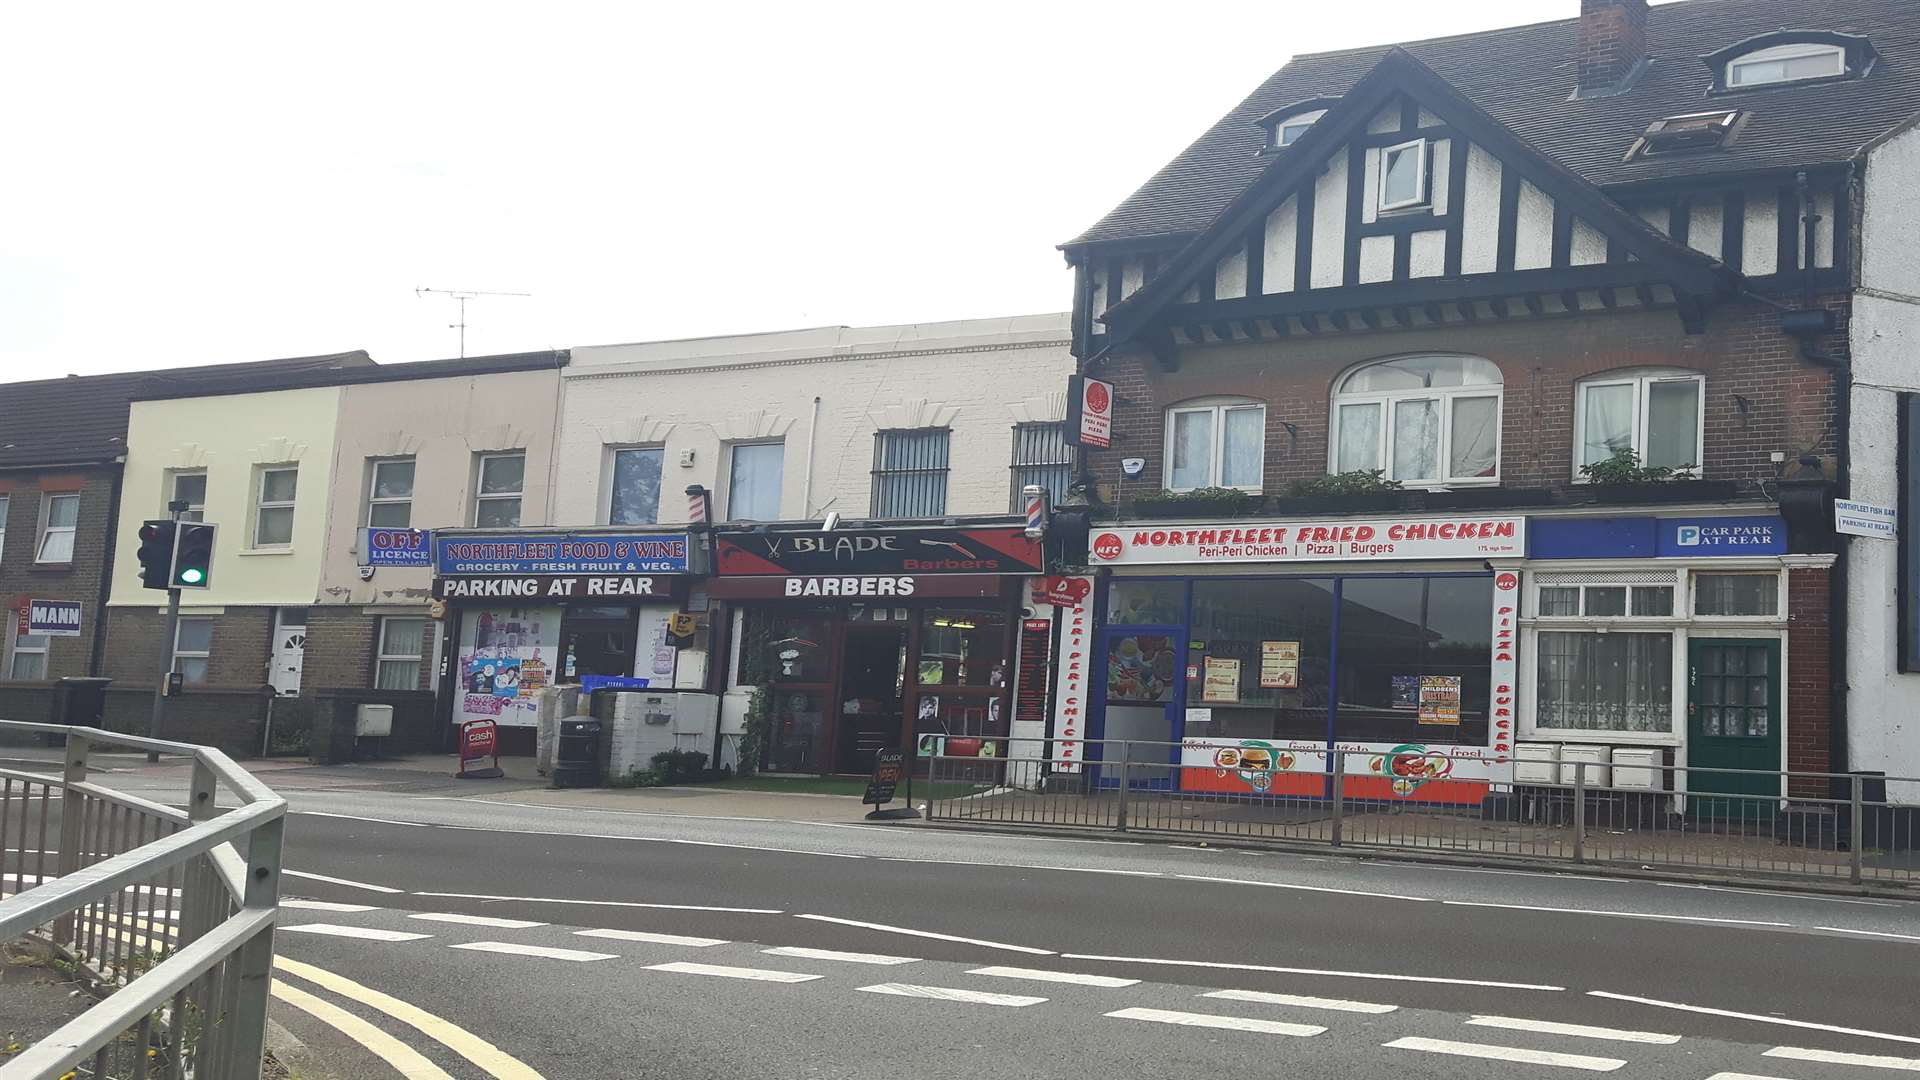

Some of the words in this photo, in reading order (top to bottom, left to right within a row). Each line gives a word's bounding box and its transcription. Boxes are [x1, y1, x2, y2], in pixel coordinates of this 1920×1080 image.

[1836, 502, 1869, 513] NORTHFLEET
[1870, 506, 1883, 515] FISH
[1131, 528, 1287, 546] NORTHFLEET
[1297, 525, 1376, 543] FRIED
[1388, 521, 1516, 540] CHICKEN
[1701, 527, 1729, 535] CAR
[1734, 526, 1773, 535] PARK
[1842, 520, 1867, 528] PARKING
[1875, 523, 1889, 531] REAR
[373, 531, 422, 550] OFF
[788, 536, 905, 561] BLADE
[1701, 536, 1722, 545] AT
[1728, 535, 1772, 544] REAR
[372, 550, 429, 559] LICENCE
[447, 543, 558, 560] NORTHFLEET
[560, 542, 611, 559] FOOD
[614, 541, 630, 559] &
[632, 541, 685, 558] WINE
[1200, 546, 1242, 557] Peri-Peri
[1245, 545, 1287, 556] Chicken
[1306, 544, 1335, 555] Pizza
[1350, 542, 1394, 556] Burgers
[456, 563, 519, 571] GROCERY
[532, 563, 576, 571] FRESH
[581, 562, 622, 571] FRUIT
[626, 562, 636, 571] &
[641, 562, 675, 570] VEG.
[904, 559, 998, 570] Barbers
[443, 578, 539, 597] PARKING
[547, 579, 577, 596] AT
[587, 578, 653, 595] REAR
[785, 576, 914, 597] BARBERS
[32, 606, 79, 624] MANN
[1071, 607, 1085, 646] PERI
[1496, 606, 1513, 661] PIZZA
[1067, 652, 1082, 691] PERI
[469, 730, 492, 742] cash
